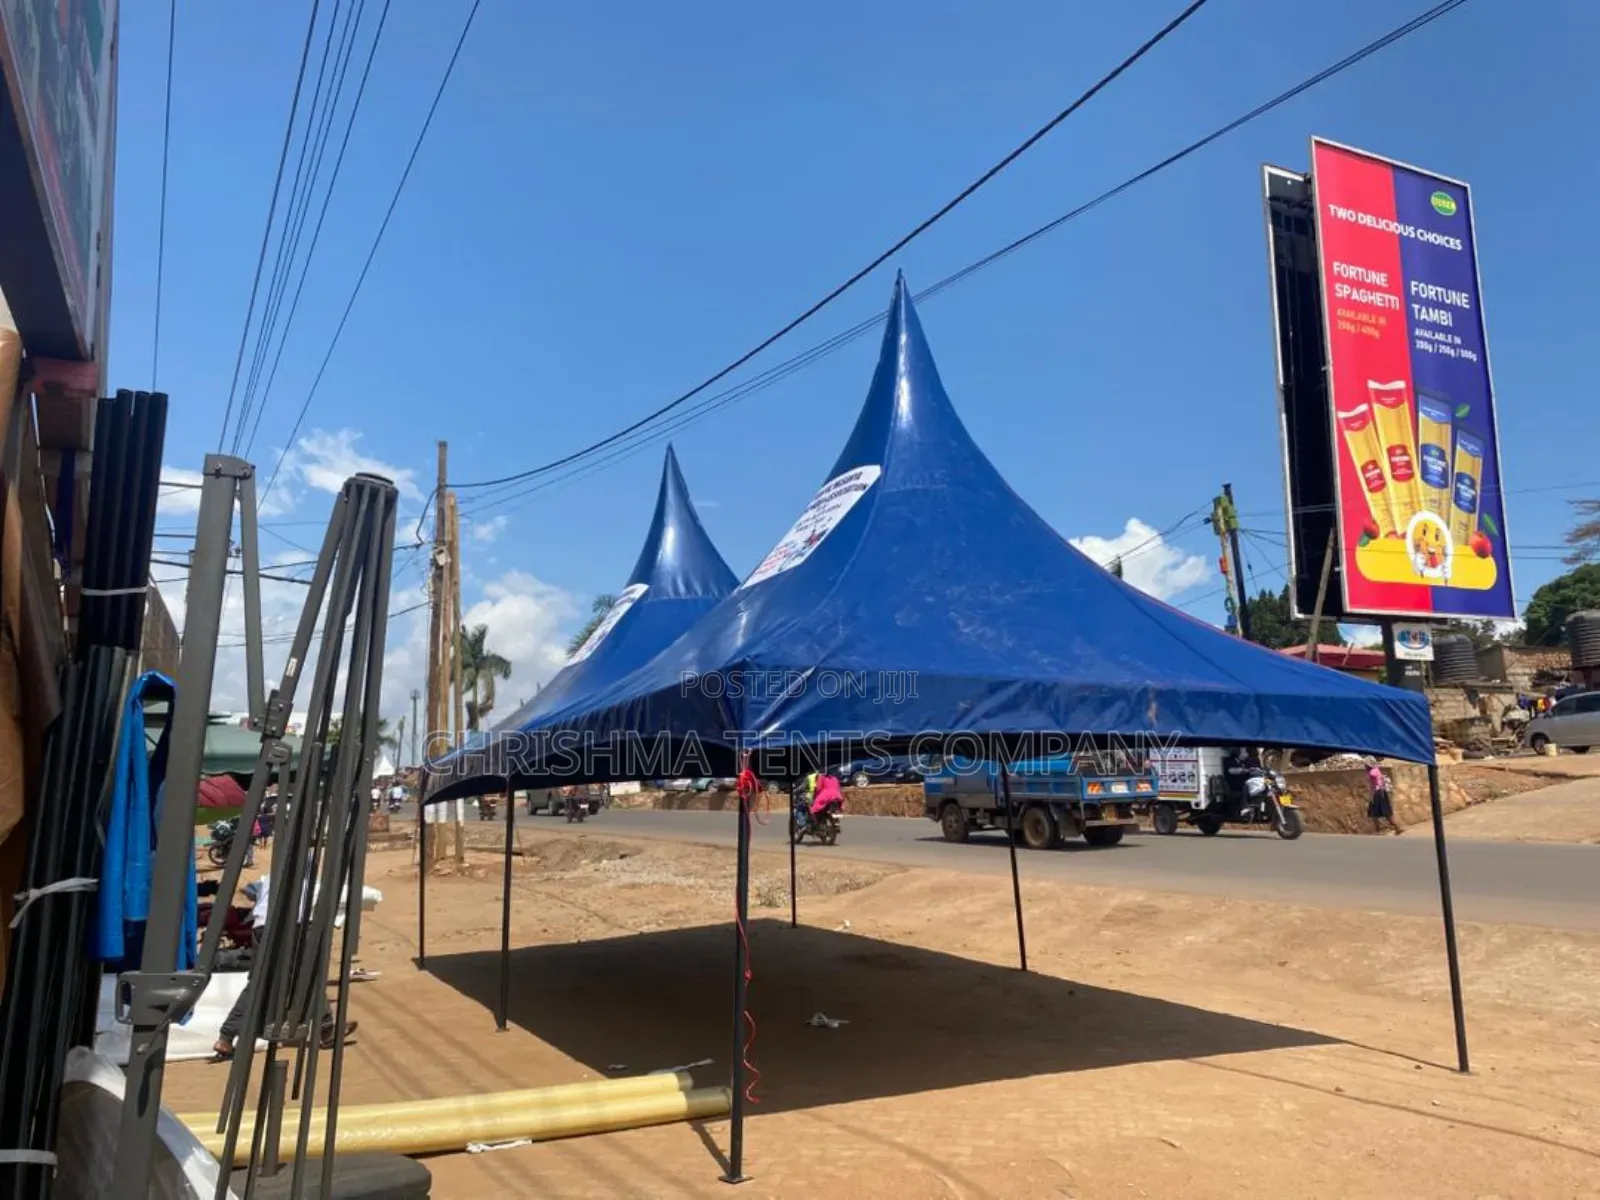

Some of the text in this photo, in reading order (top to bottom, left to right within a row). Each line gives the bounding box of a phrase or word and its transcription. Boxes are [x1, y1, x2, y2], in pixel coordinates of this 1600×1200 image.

[1328, 204, 1463, 251] TWO DELICIOUS CHOICES
[1333, 261, 1388, 287] FORTUNE
[1334, 284, 1400, 310] SPAGHETTI
[1410, 280, 1470, 308] FORTUNE
[1336, 308, 1376, 325] AVAILABLE
[1411, 304, 1453, 327] TAMBI
[1415, 328, 1453, 345] AVAILABLE
